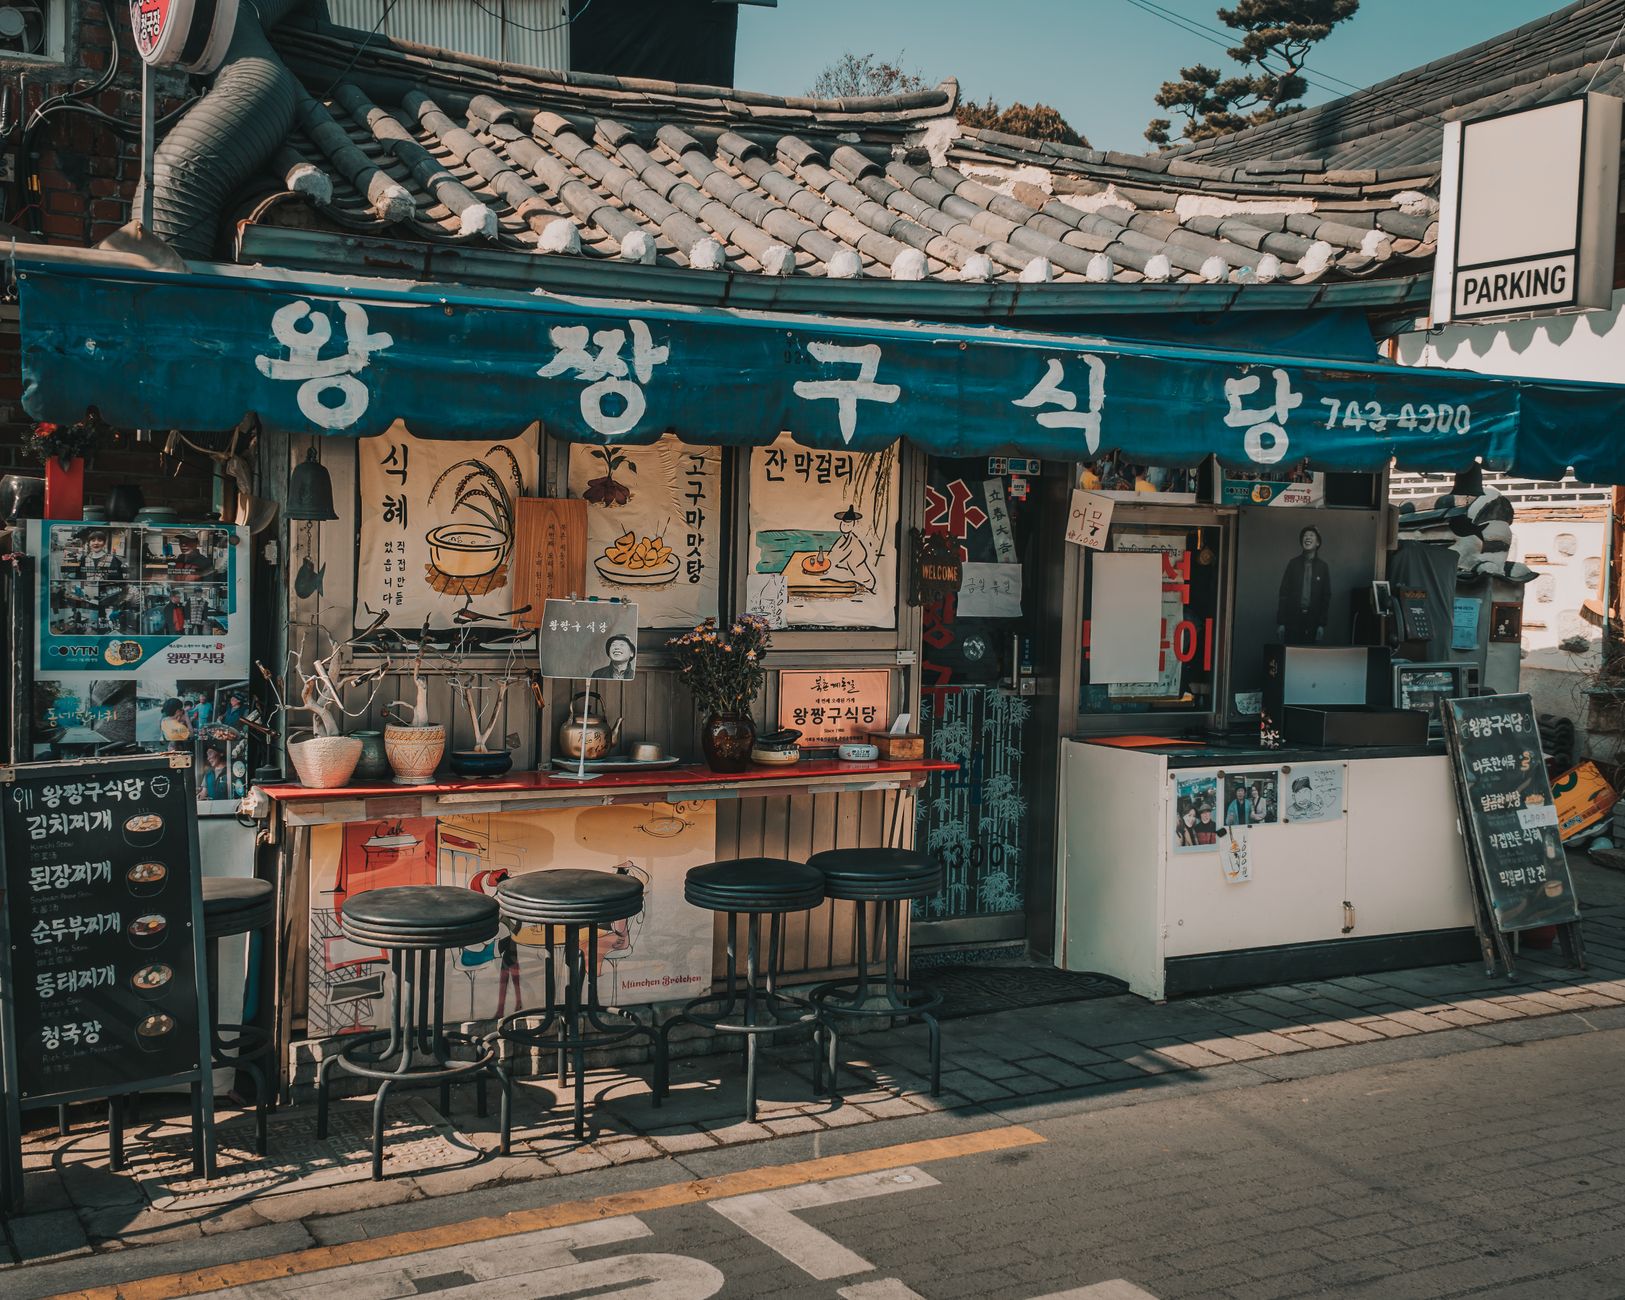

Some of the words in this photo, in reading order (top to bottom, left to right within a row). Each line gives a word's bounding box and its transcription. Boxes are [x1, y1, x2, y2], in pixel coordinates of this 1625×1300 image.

[140, 9, 160, 40] 청국장
[1463, 265, 1567, 307] PARKING
[1320, 397, 1472, 435] 743-4300
[764, 449, 788, 482] 잔
[794, 452, 854, 484] 막걸리
[380, 443, 409, 530] 식혜
[988, 488, 1013, 554] 立春大吉
[1072, 507, 1105, 537] 어묵
[921, 565, 957, 582] WELCOME
[965, 577, 986, 594] 금일
[549, 619, 582, 633] 왕짱구
[586, 621, 609, 634] 식당
[70, 645, 99, 657] YTN
[166, 652, 225, 665] 왕짱구식당
[793, 706, 876, 726] 왕짱구식당
[1468, 712, 1524, 738] 왕짱구식당
[40, 777, 145, 808] 왕짱구식당
[26, 808, 113, 840] 김치찌개
[28, 860, 112, 892] 된장찌개
[30, 911, 121, 945] 순두부찌개
[35, 964, 116, 999] 동태찌개
[620, 978, 661, 991] München
[661, 974, 702, 987] Brötchen
[41, 1019, 103, 1050] 청국장
